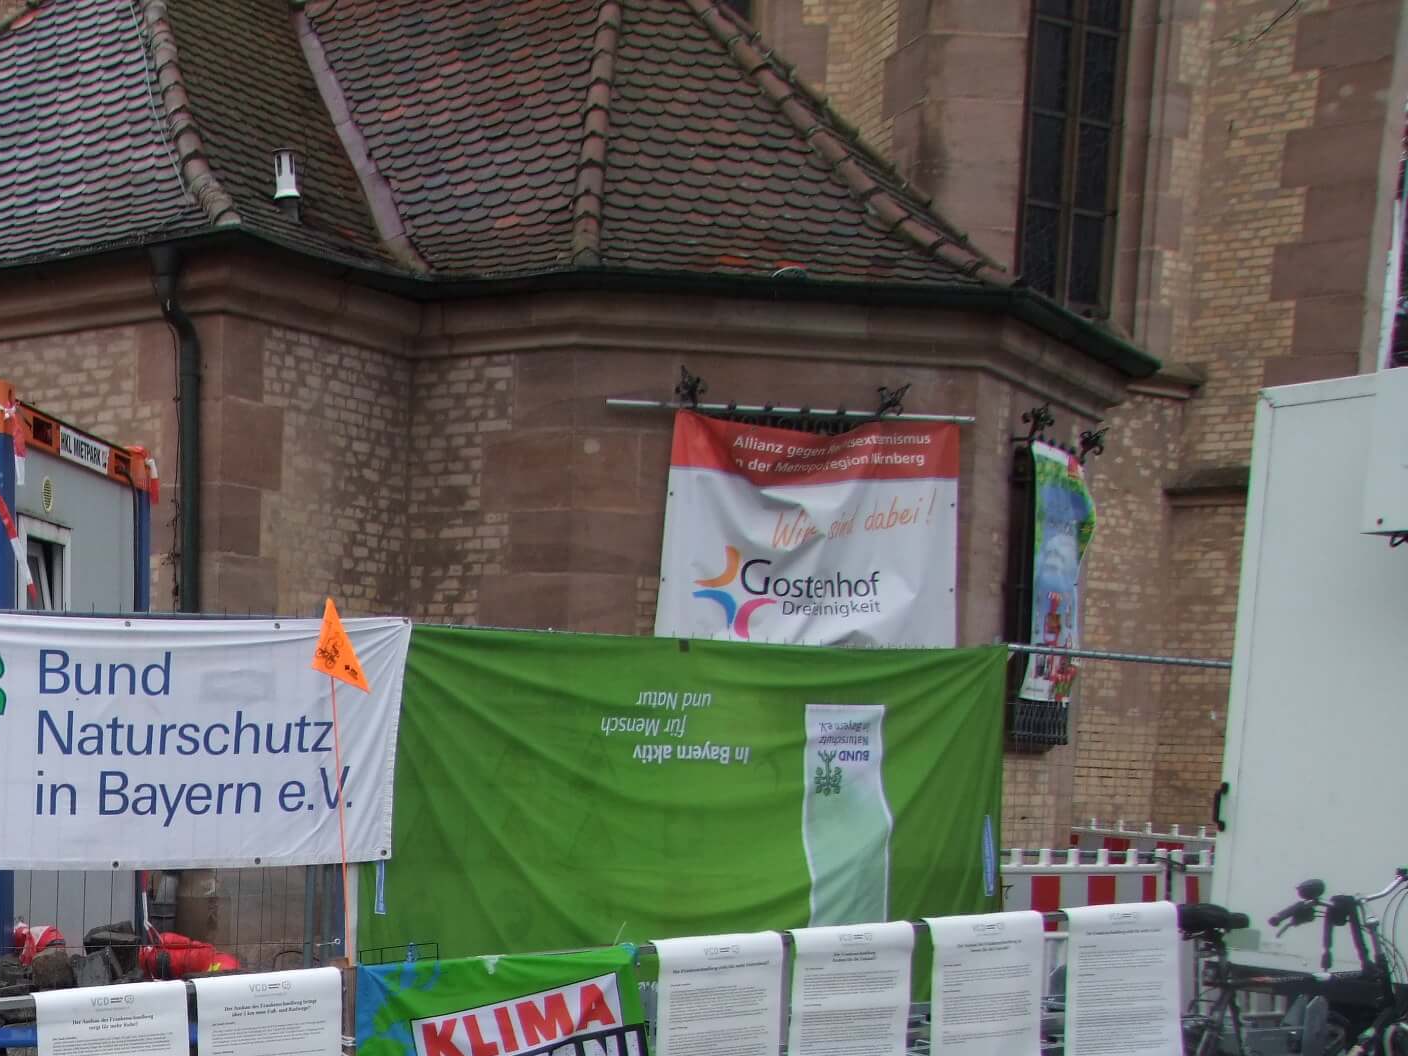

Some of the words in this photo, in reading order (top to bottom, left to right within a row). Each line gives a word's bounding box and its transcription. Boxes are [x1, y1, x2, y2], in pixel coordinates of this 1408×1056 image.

[733, 435, 784, 454] Allianz
[787, 445, 826, 459] gegen
[748, 459, 772, 473] der
[771, 507, 817, 549] Wir
[740, 558, 880, 600] Gostenhof
[38, 649, 172, 697] Bund
[636, 691, 677, 710] Natur
[681, 693, 712, 711] und
[36, 710, 334, 757] Naturschutz
[601, 716, 660, 737] Mensch
[664, 714, 687, 737] für
[633, 744, 672, 764] aktiv
[677, 742, 730, 764] Bayern
[735, 747, 750, 764] In
[838, 750, 870, 761] BUND
[35, 770, 78, 817] in
[98, 769, 263, 828] Bayern
[278, 766, 354, 812] e.V.
